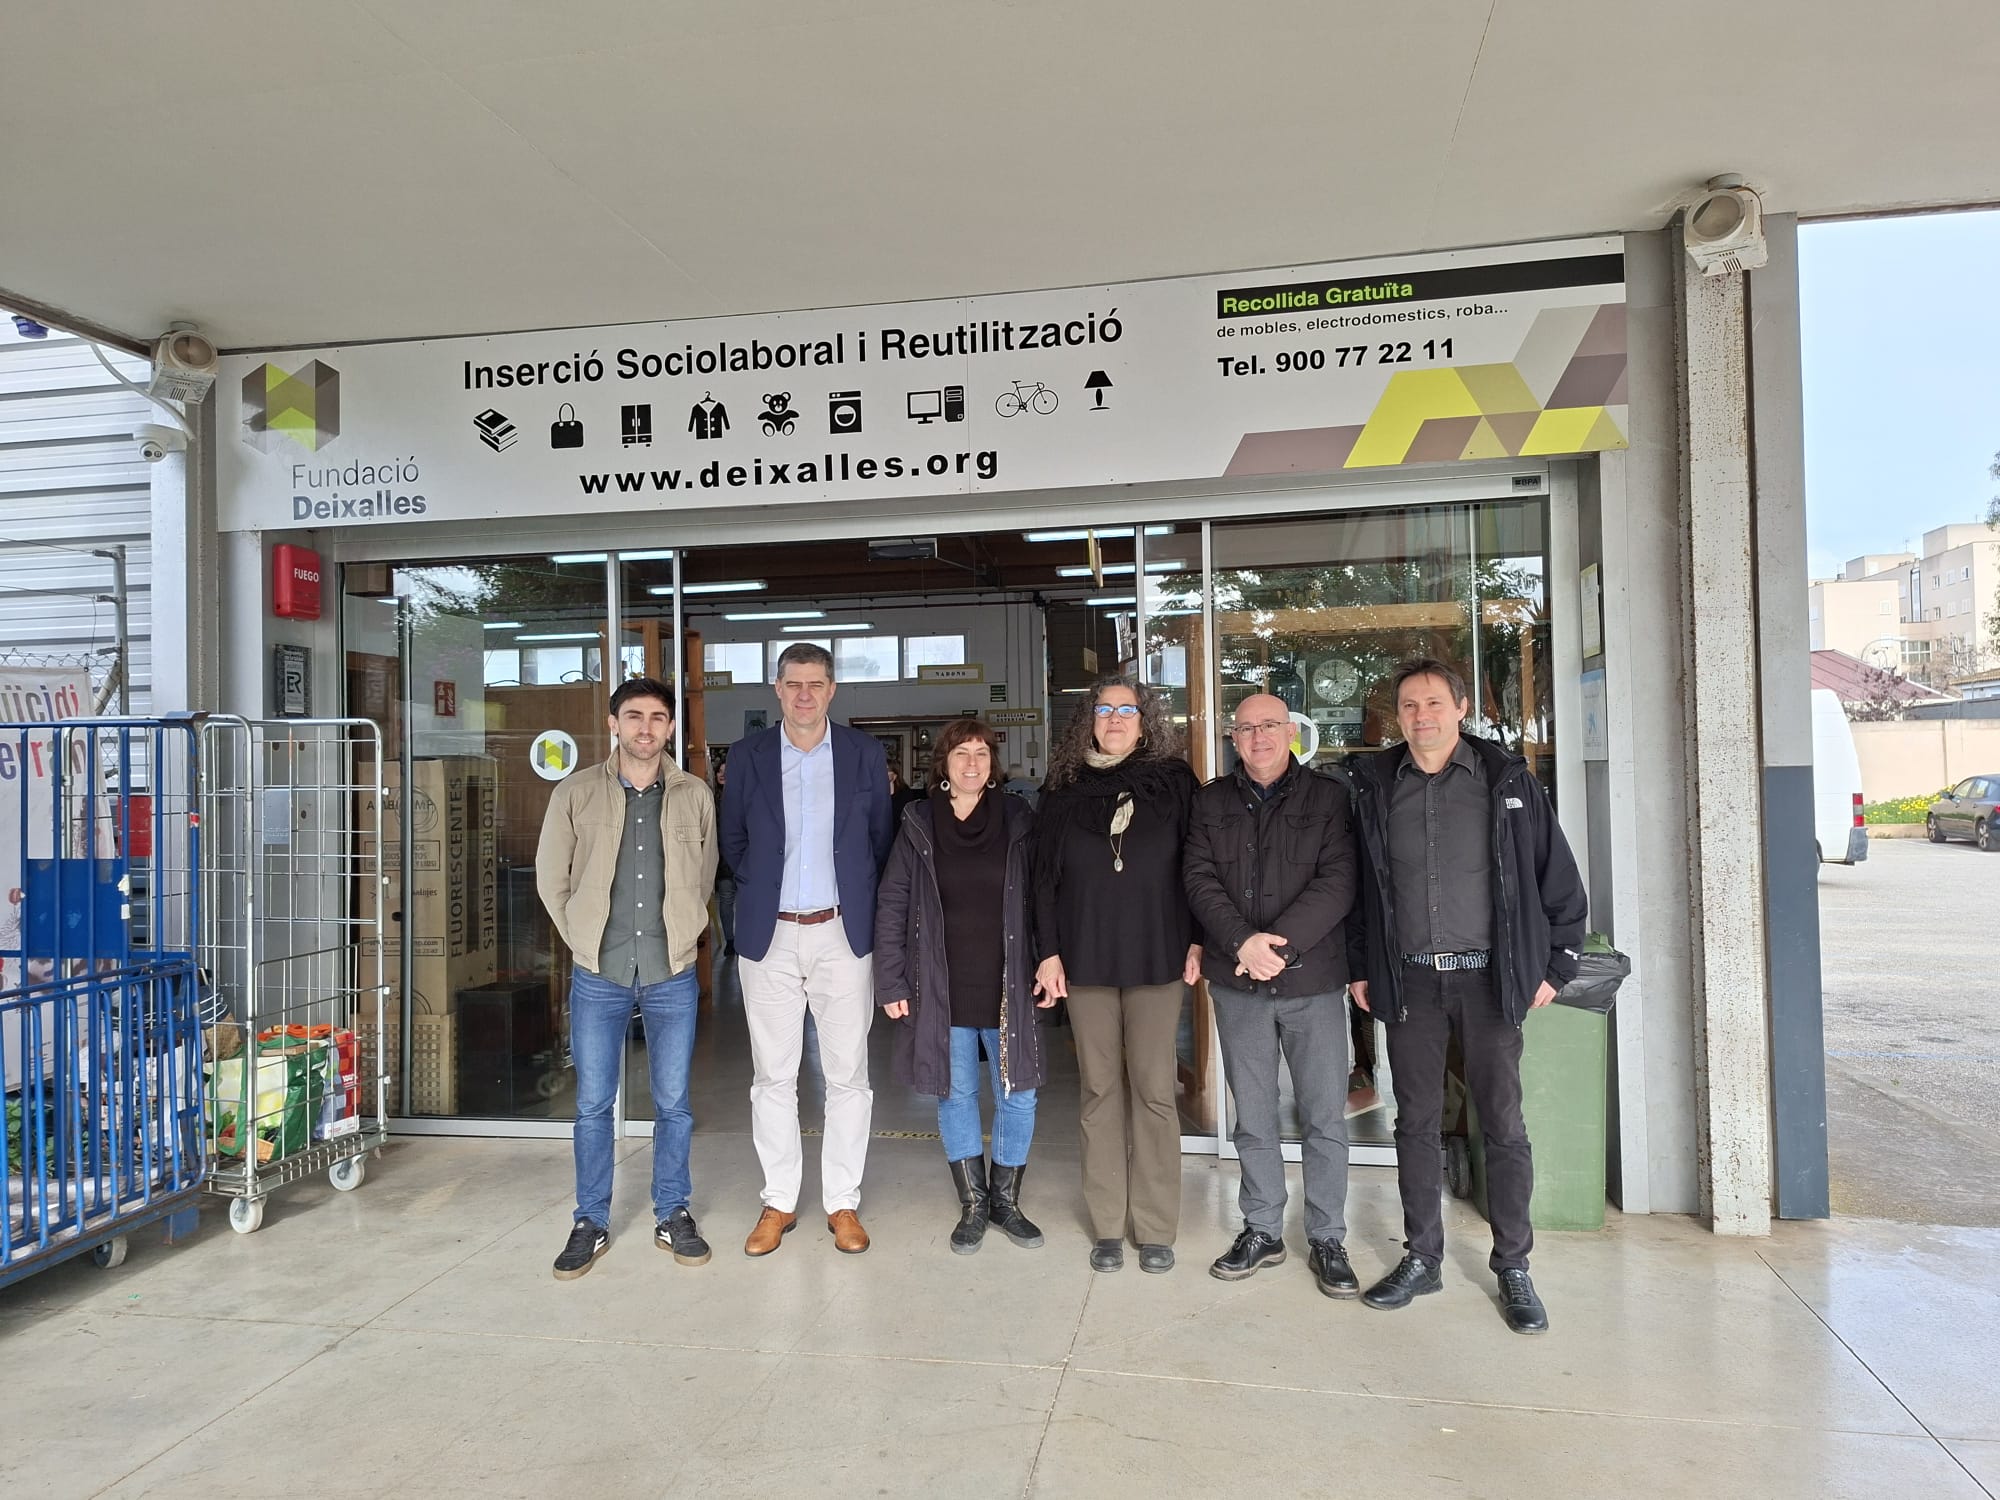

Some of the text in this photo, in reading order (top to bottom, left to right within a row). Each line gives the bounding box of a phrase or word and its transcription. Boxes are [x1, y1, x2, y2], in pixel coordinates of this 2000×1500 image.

[1223, 281, 1413, 314] Recollida Gratuïta
[1216, 303, 1508, 338] de mobles, electrodomestics, roba...
[464, 307, 1123, 390] Inserció Sociolaboral i Reutilització
[1217, 337, 1453, 377] Tel. 900 77 22 11
[292, 455, 420, 489] Fundació
[579, 450, 998, 494] www.deixalles.org
[292, 489, 427, 521] Deixalles
[293, 567, 320, 583] FUEGO
[0, 740, 87, 780] ern
[450, 776, 463, 958] FLUORESCENTES
[482, 776, 495, 951] FLUORESCENTES
